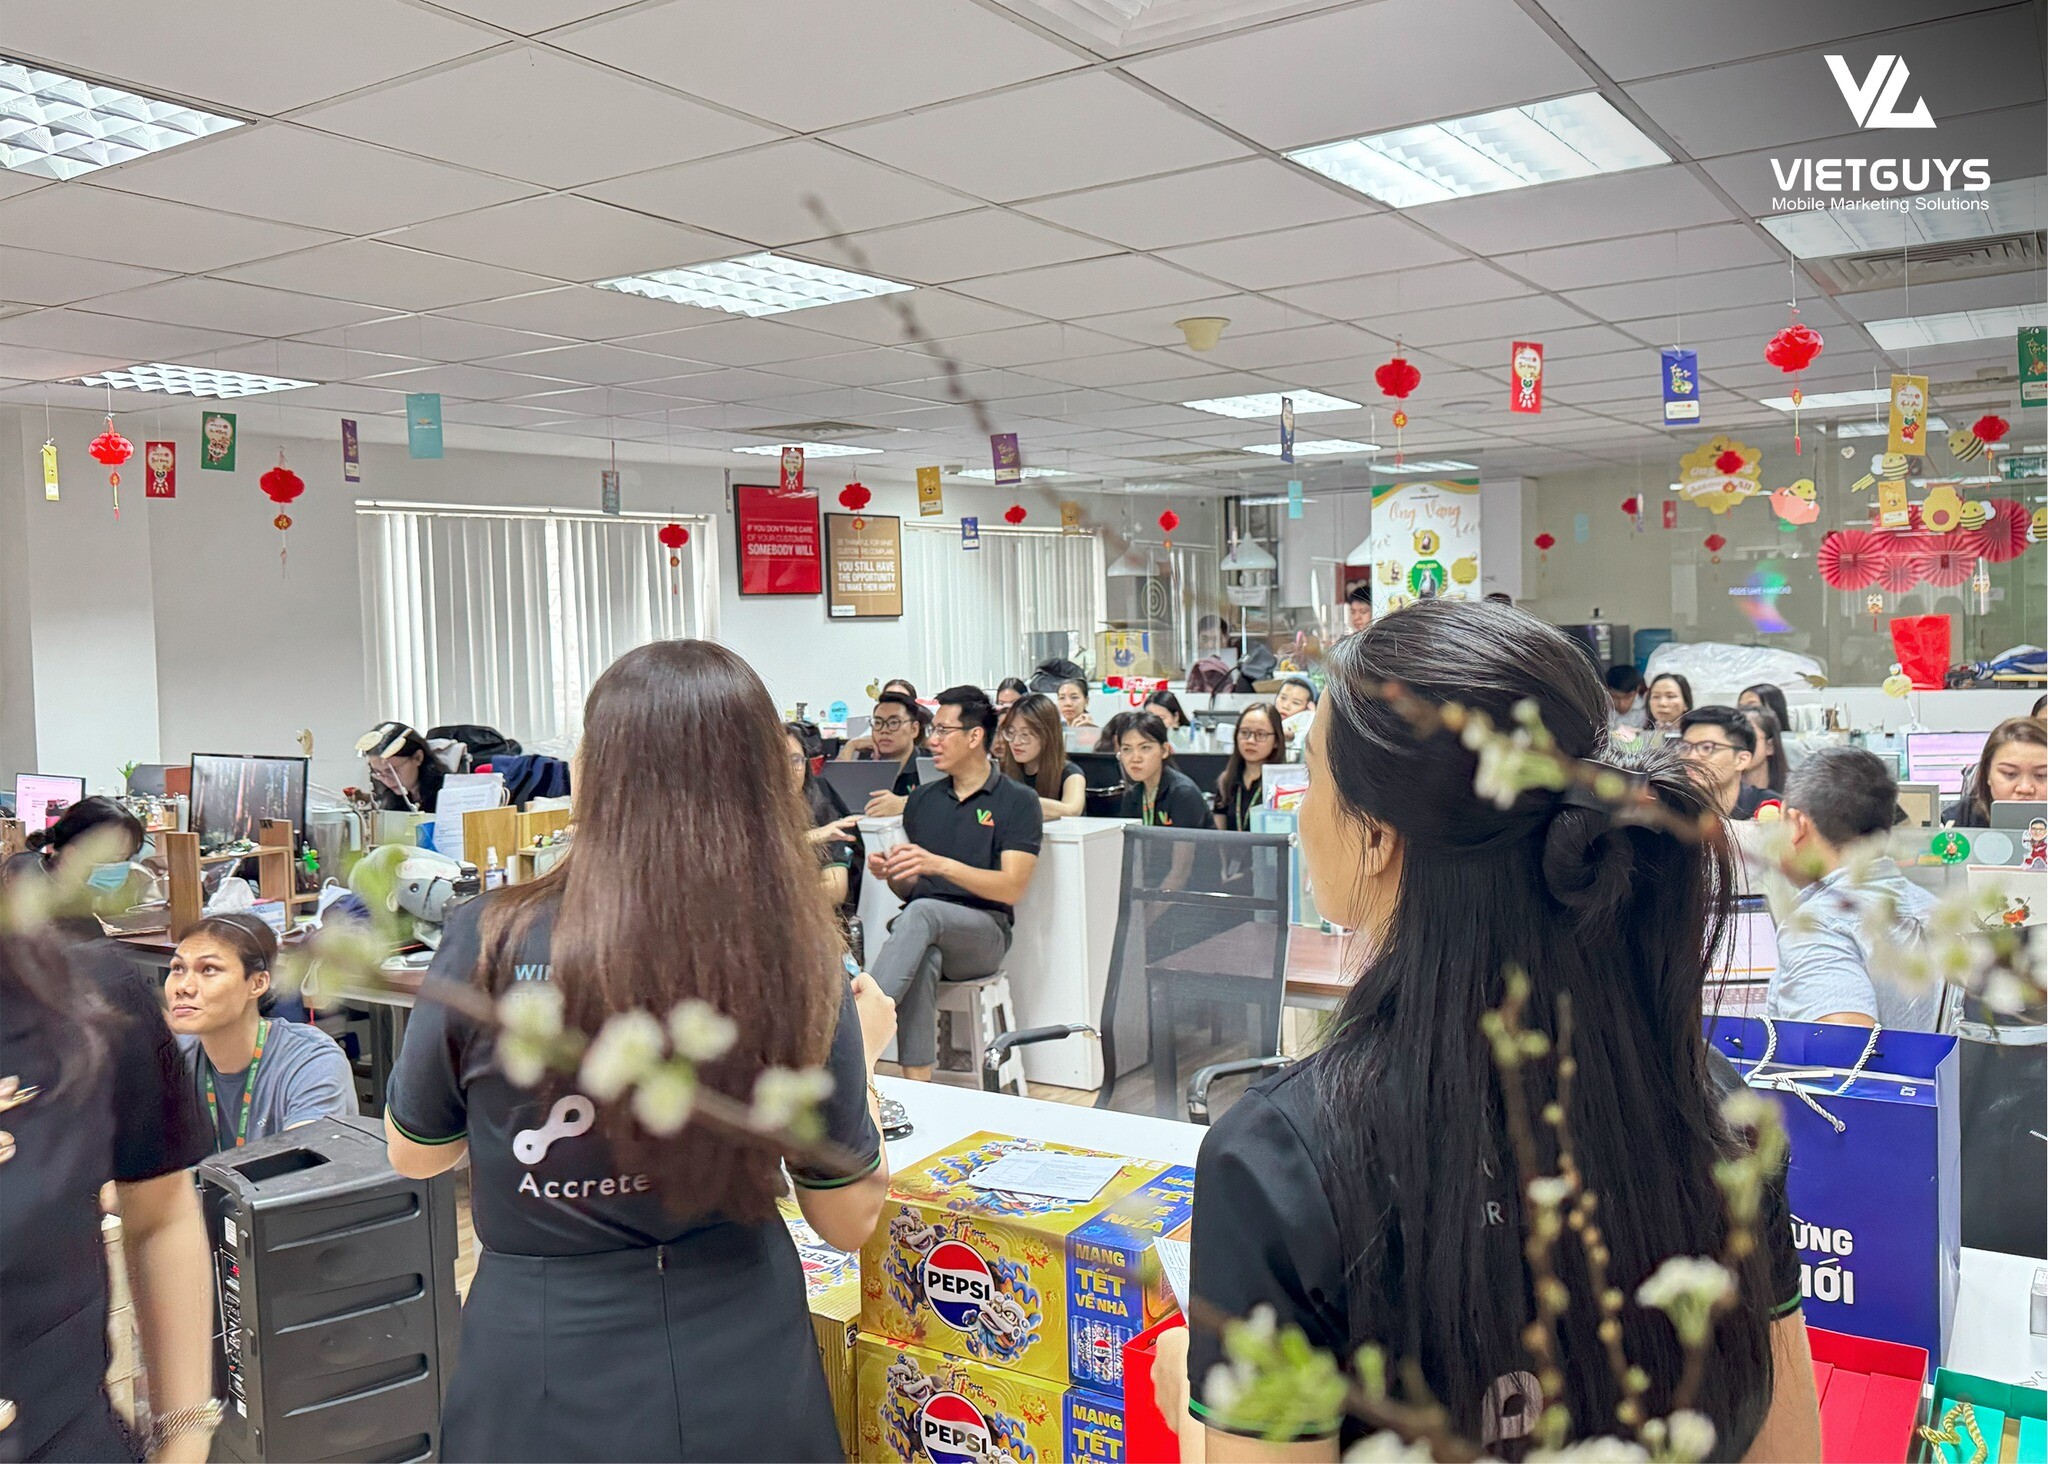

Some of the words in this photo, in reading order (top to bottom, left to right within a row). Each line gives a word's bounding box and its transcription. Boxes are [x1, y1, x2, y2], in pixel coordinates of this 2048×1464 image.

[757, 534, 775, 542] YOUR
[766, 525, 784, 533] DON'T
[798, 526, 813, 534] CARE
[747, 543, 794, 555] SOMEBODY
[795, 544, 815, 556] WILL
[837, 561, 853, 571] YOU
[854, 561, 874, 572] STILL
[876, 561, 895, 572] HAVE
[838, 572, 851, 582] THE
[852, 572, 896, 582] OPPORTUNITY
[838, 583, 846, 592] TO
[847, 583, 862, 592] MAKE
[879, 583, 896, 592] HAPPY
[518, 1172, 651, 1198] Accrete
[1075, 1243, 1126, 1268] MANG
[928, 1271, 990, 1301] PEPSI
[1075, 1267, 1126, 1297] TẾT
[1096, 1297, 1129, 1317] NHÀ
[1072, 1404, 1123, 1431] MANG
[924, 1421, 988, 1454] PEPSI
[1072, 1427, 1123, 1460] TẾT
